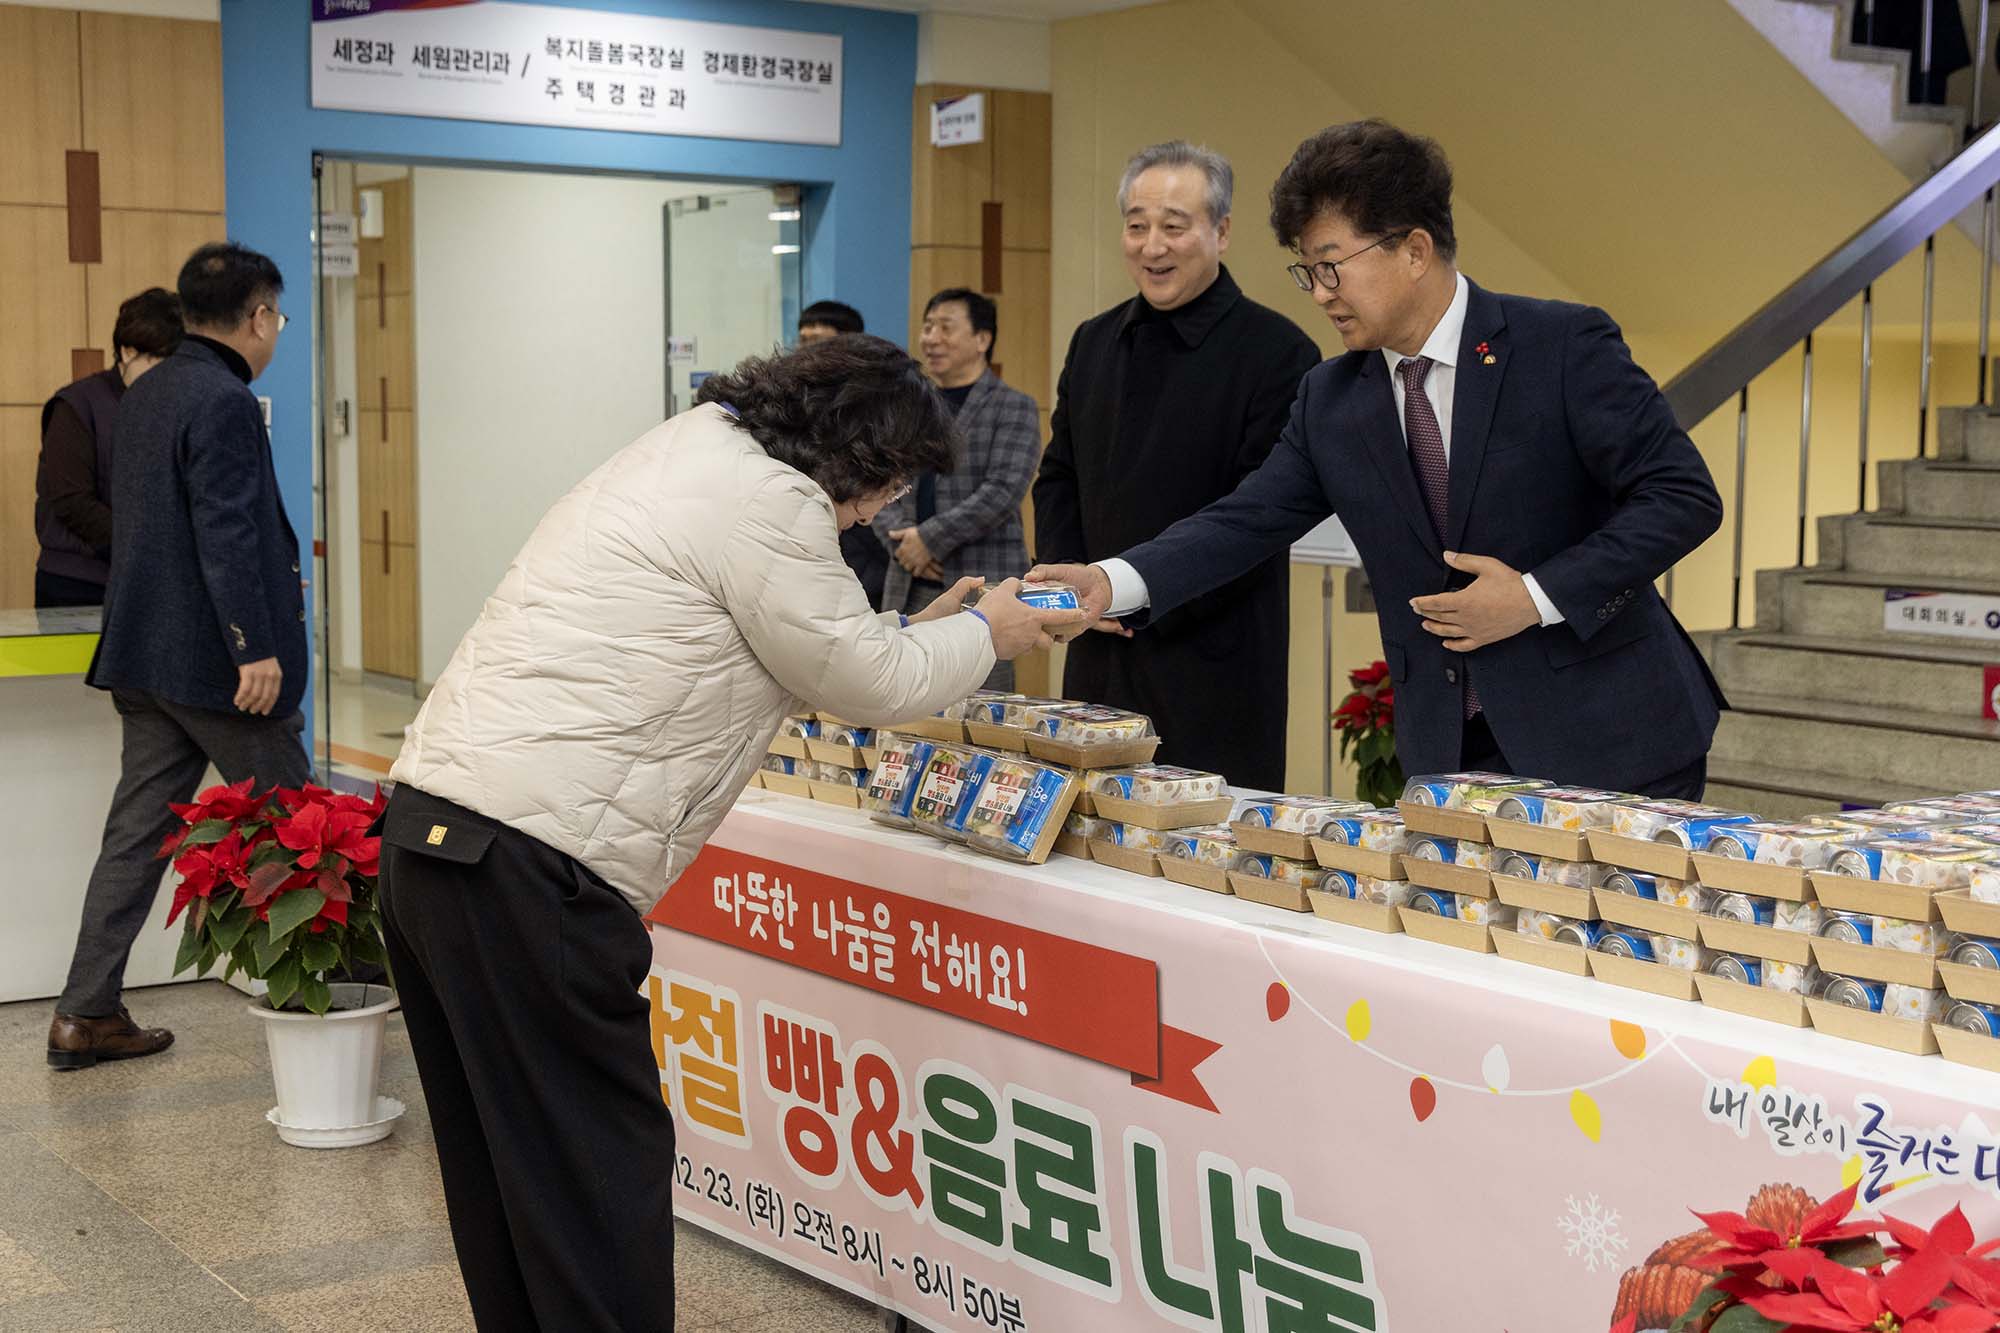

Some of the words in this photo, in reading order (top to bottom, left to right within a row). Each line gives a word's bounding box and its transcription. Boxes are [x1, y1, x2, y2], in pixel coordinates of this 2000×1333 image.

[332, 38, 395, 65] 세정과
[412, 45, 510, 75] 세원관리과
[703, 50, 833, 85] 경제환경국장실
[713, 872, 798, 950] 따뜻한
[812, 896, 896, 983] 나눔을
[909, 920, 1028, 1016] 전해요!
[1709, 1086, 1748, 1128] 내
[1761, 1094, 1845, 1152] 일상이
[1856, 1102, 1959, 1204] 즐거운
[793, 1202, 838, 1255] 오전
[842, 1225, 884, 1277] 8시
[913, 1256, 955, 1311] 8시
[963, 1277, 1025, 1333] 50분
